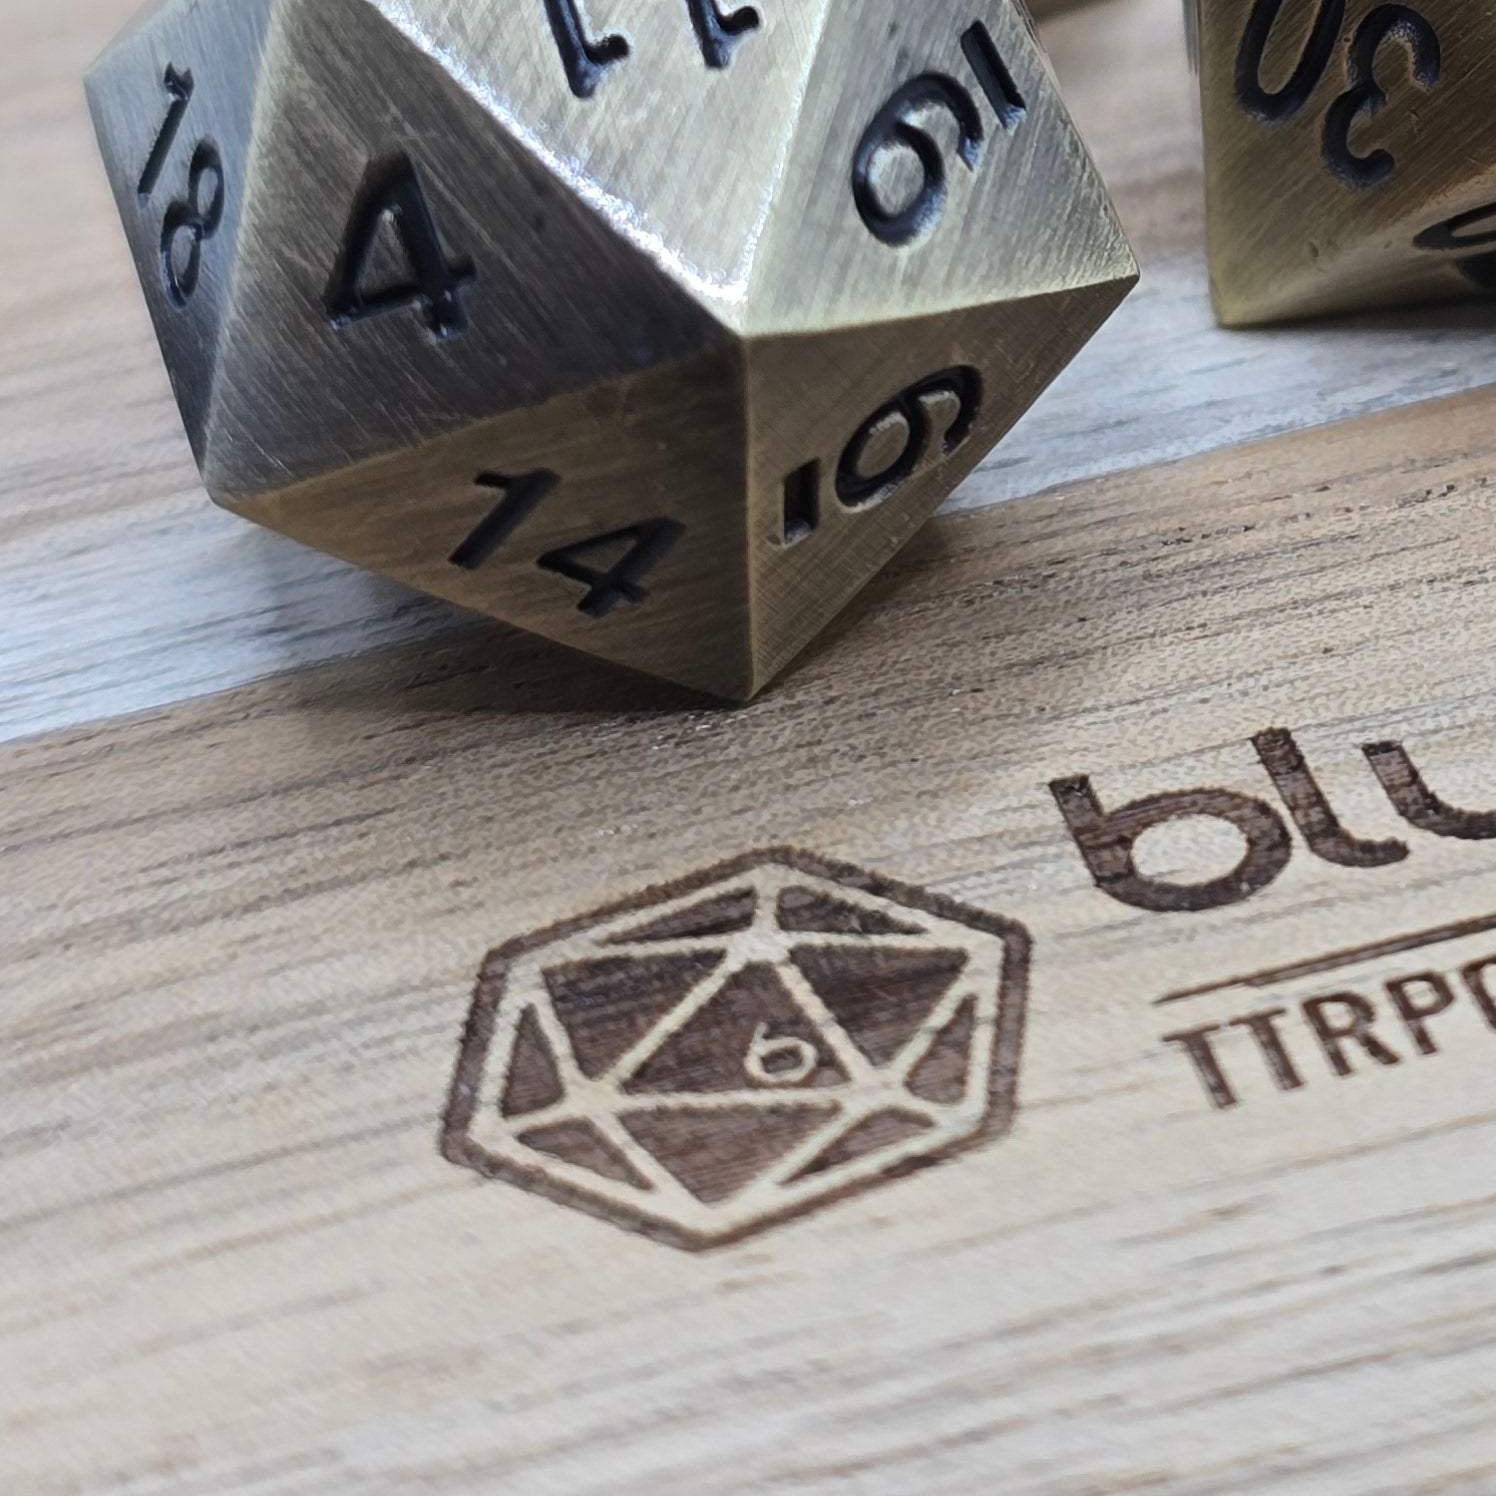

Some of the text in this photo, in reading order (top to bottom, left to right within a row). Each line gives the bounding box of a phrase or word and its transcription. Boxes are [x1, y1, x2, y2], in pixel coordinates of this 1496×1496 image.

[136, 60, 226, 308] 18
[324, 149, 478, 340] 4
[447, 465, 688, 620] 14
